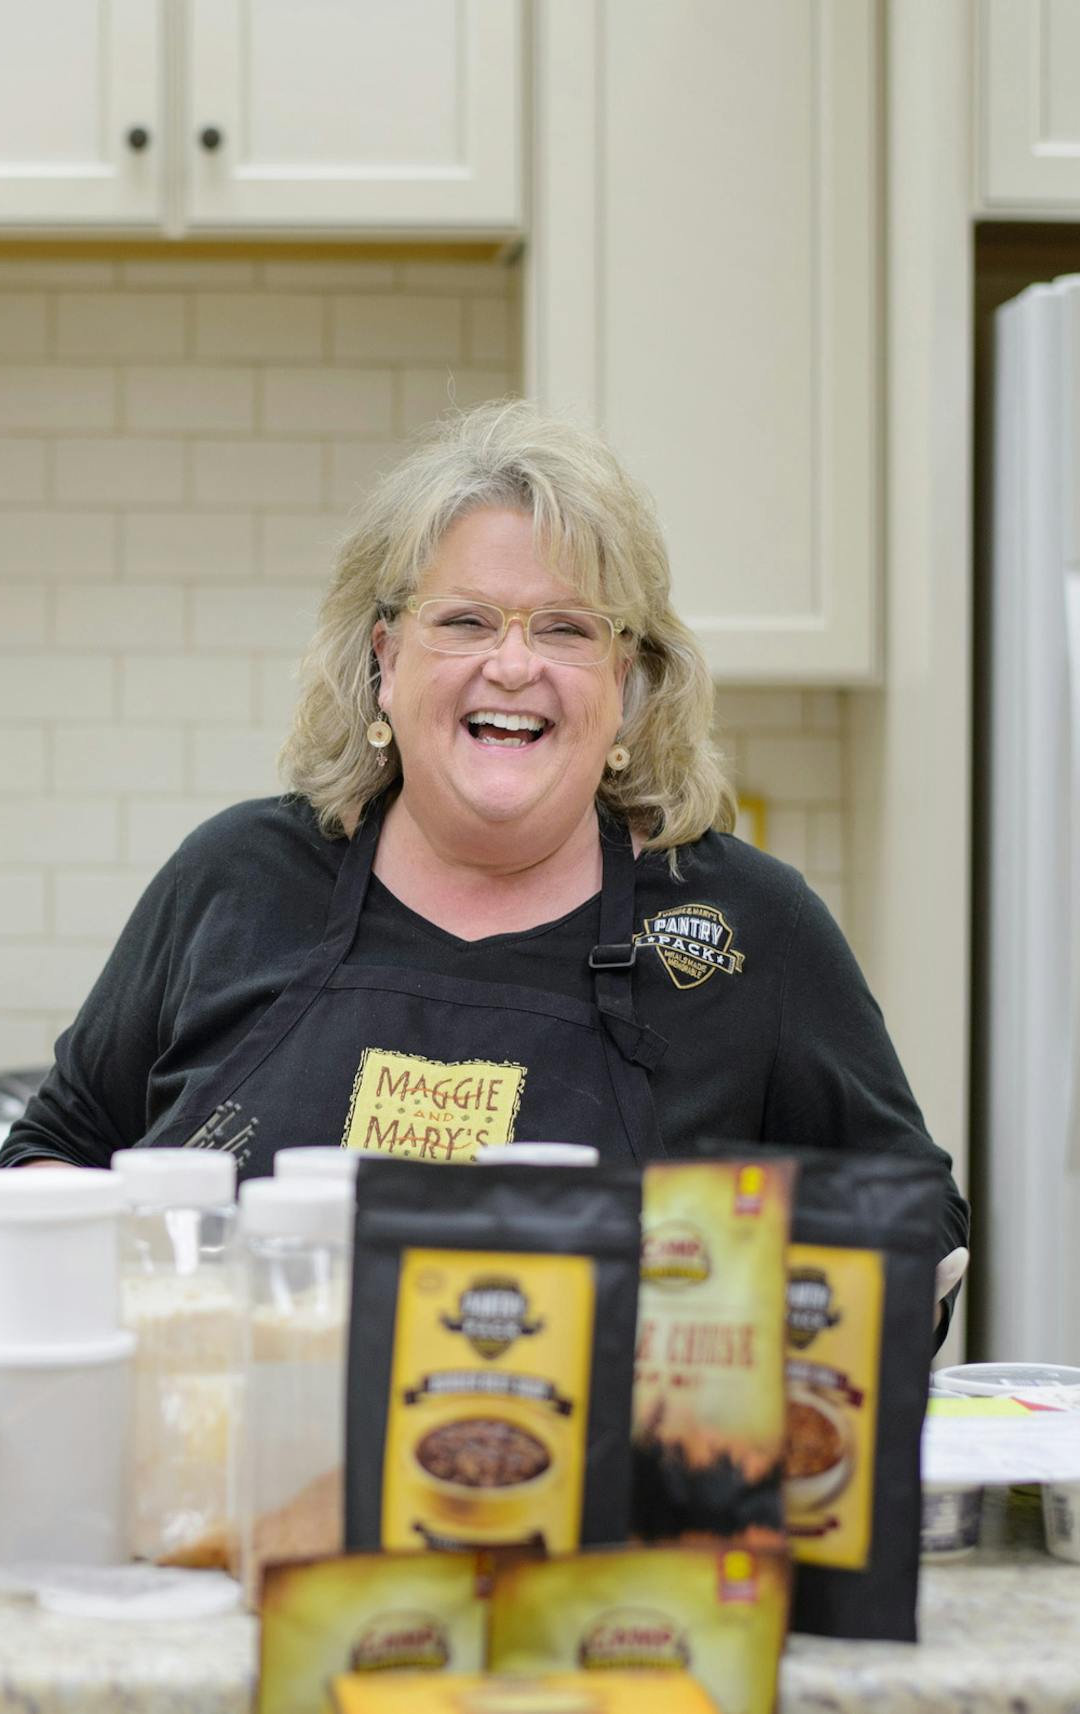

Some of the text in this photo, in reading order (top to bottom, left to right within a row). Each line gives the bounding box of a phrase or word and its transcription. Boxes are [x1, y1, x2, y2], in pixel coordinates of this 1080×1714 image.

[654, 917, 723, 945] PANTRY
[659, 935, 715, 963] PACK
[376, 1066, 503, 1111] MAGGIE
[414, 1110, 454, 1122] AND
[364, 1115, 489, 1161] MARY'S
